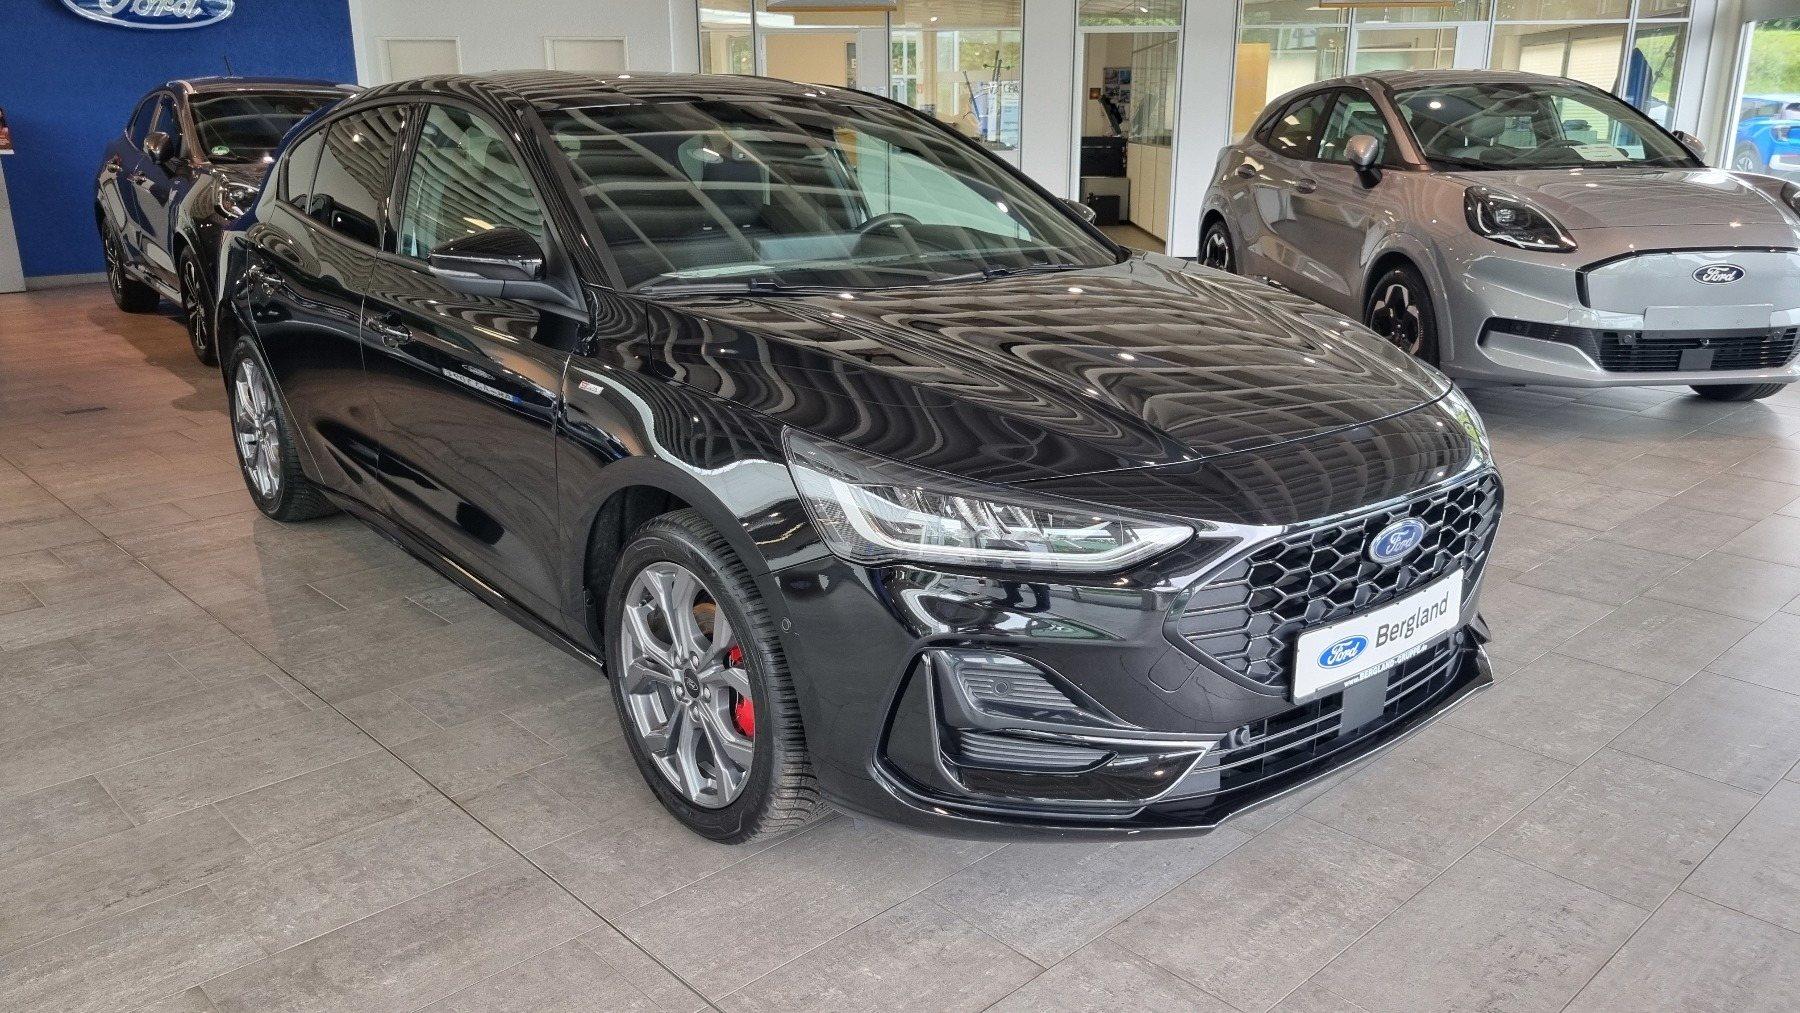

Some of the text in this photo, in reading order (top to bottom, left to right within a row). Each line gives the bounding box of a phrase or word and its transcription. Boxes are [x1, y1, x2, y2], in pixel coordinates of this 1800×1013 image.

[1702, 267, 1737, 281] Ford
[1386, 529, 1416, 555] Ford
[1375, 591, 1449, 648] Bergland
[1327, 640, 1361, 665] Ford
